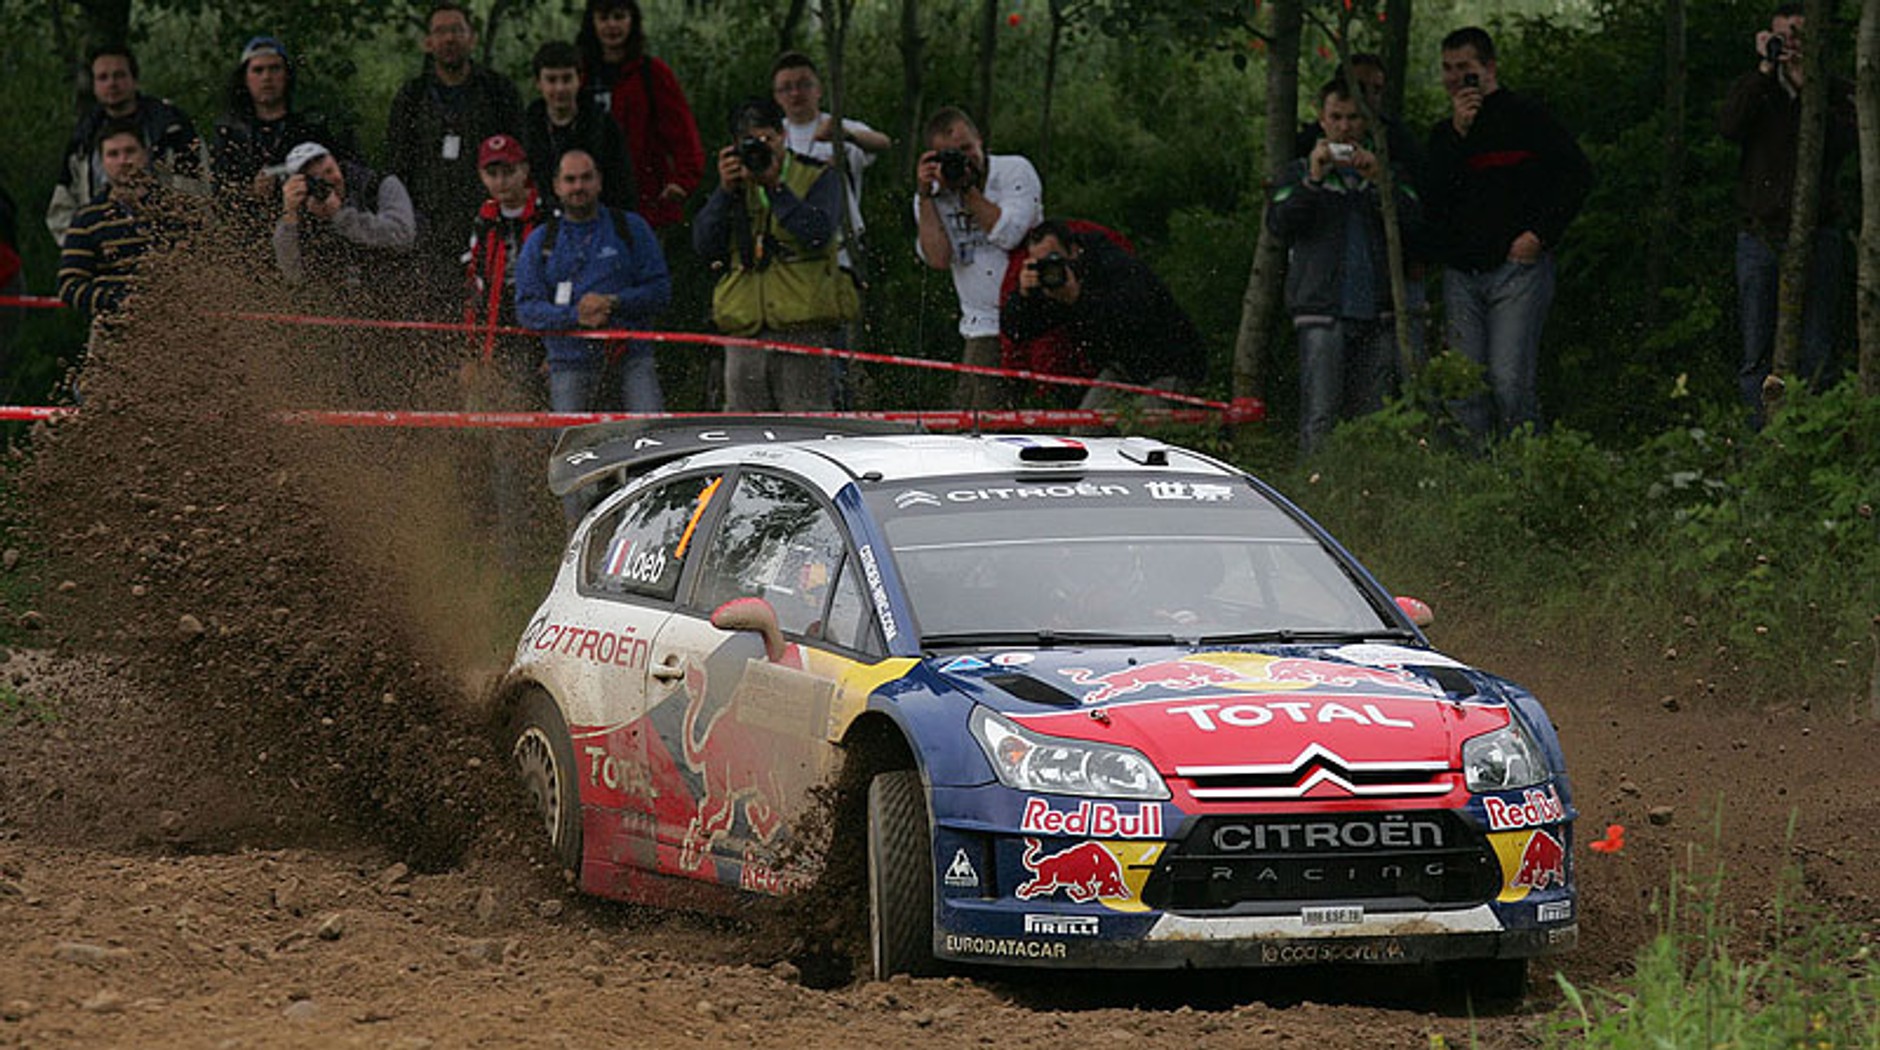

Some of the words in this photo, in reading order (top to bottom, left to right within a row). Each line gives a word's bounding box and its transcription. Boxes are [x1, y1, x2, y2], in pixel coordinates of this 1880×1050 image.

[946, 481, 1130, 502] CITROËN
[621, 541, 667, 583] Loeb
[535, 624, 649, 670] CITROËN
[1166, 702, 1415, 731] TOTAL
[1021, 797, 1091, 835] Red
[1091, 802, 1163, 838] Bull
[1213, 815, 1444, 850] CITROËN
[1211, 863, 1445, 882] RACING
[1024, 914, 1099, 935] PIRELLI
[946, 935, 1067, 958] EURODATACAR
